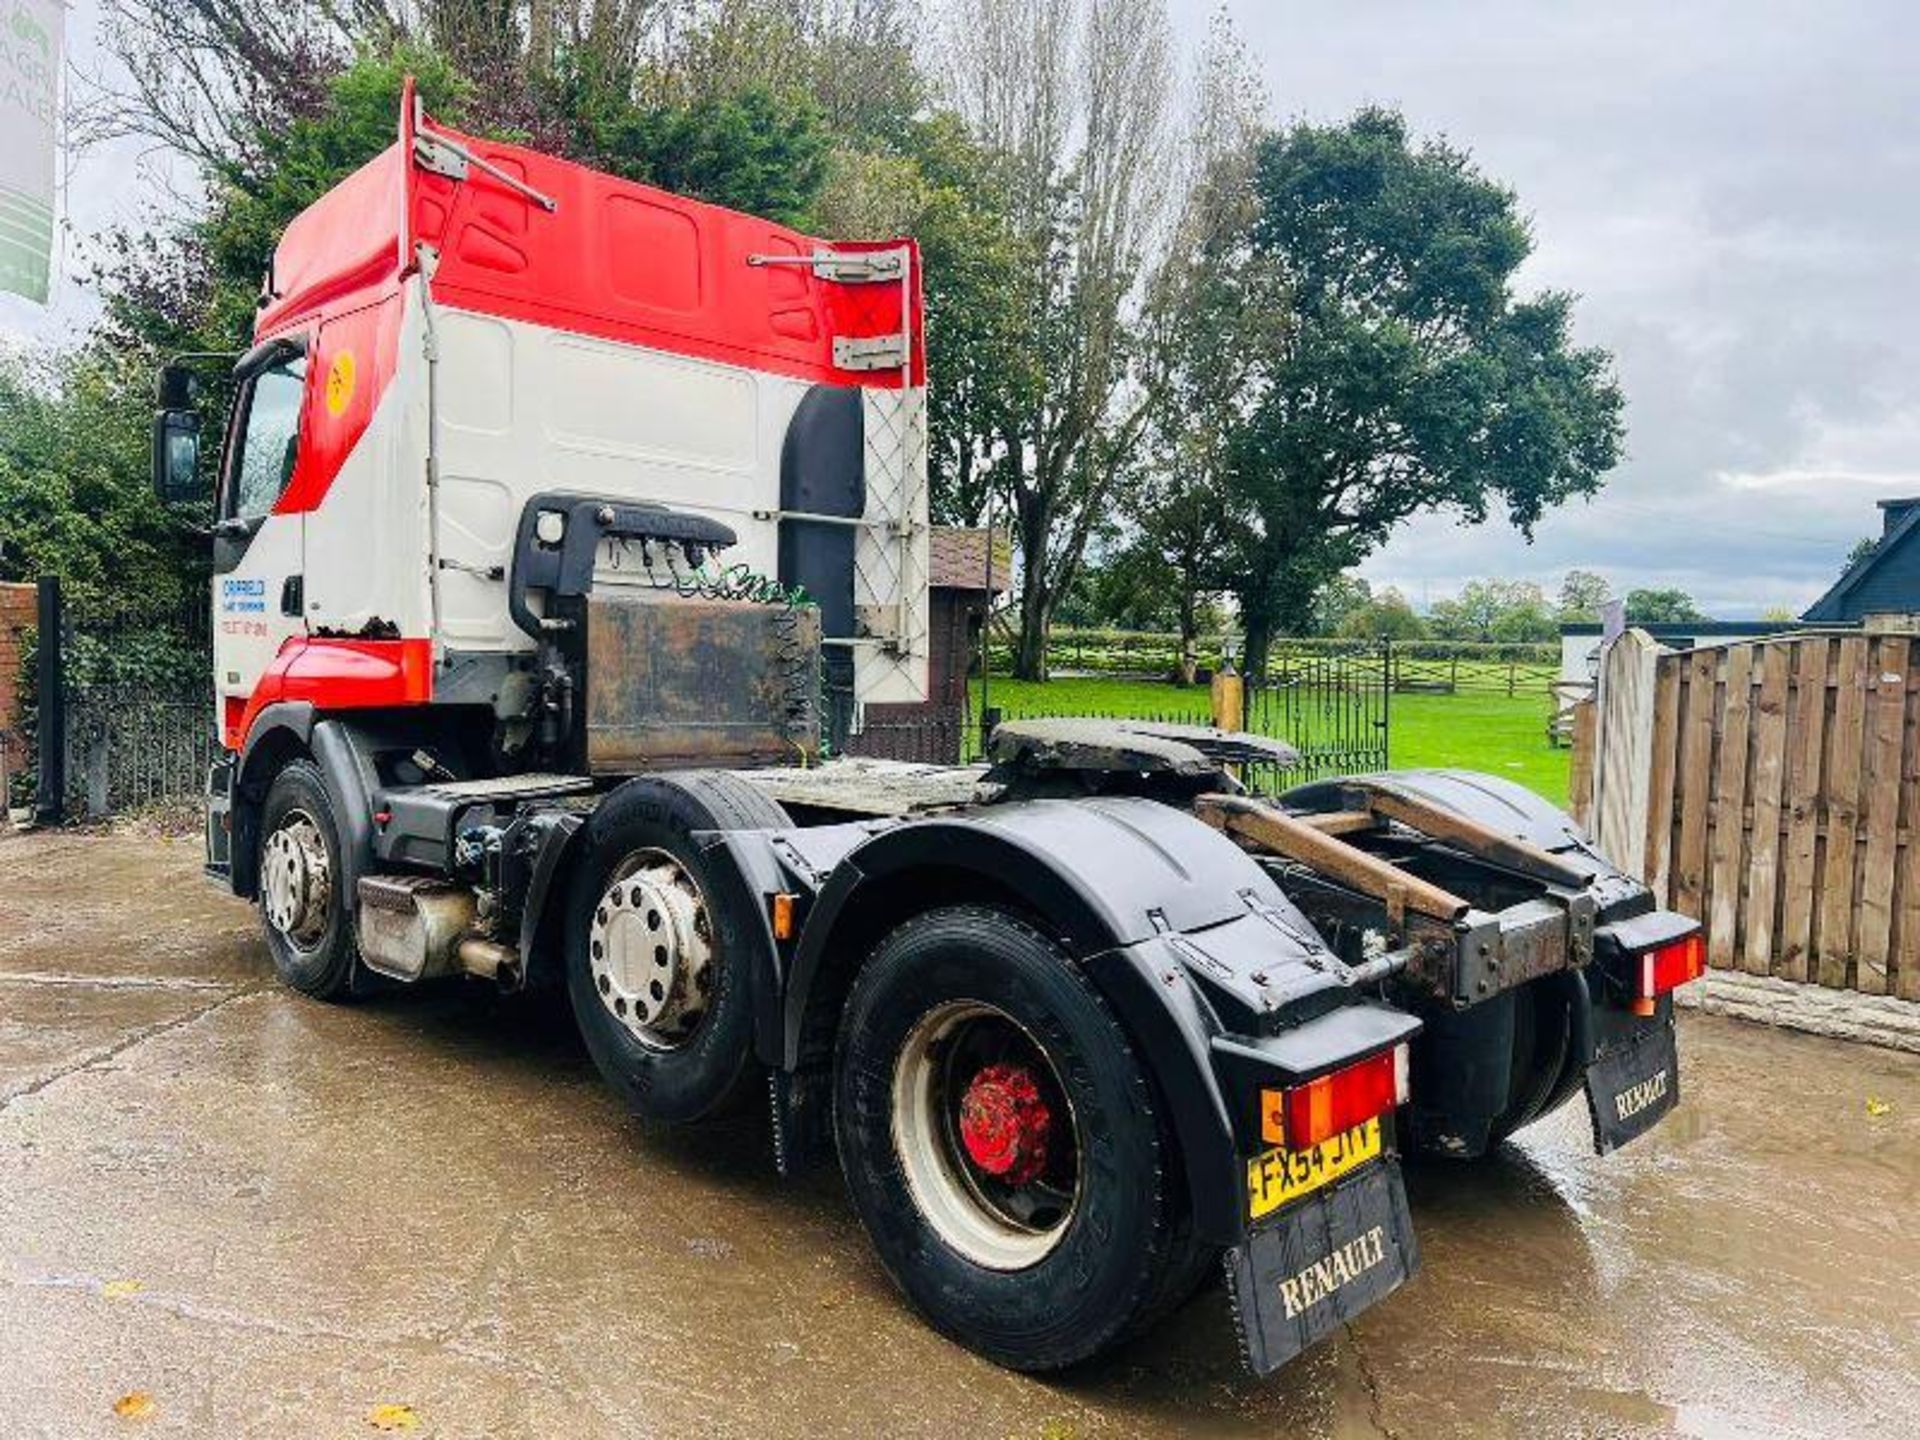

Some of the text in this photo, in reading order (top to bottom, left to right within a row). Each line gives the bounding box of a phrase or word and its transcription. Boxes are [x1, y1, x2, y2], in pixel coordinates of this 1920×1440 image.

[1614, 1069, 1667, 1122] RENAULT
[1258, 1145, 1325, 1201] FX54
[1279, 1224, 1385, 1321] RENAULT
